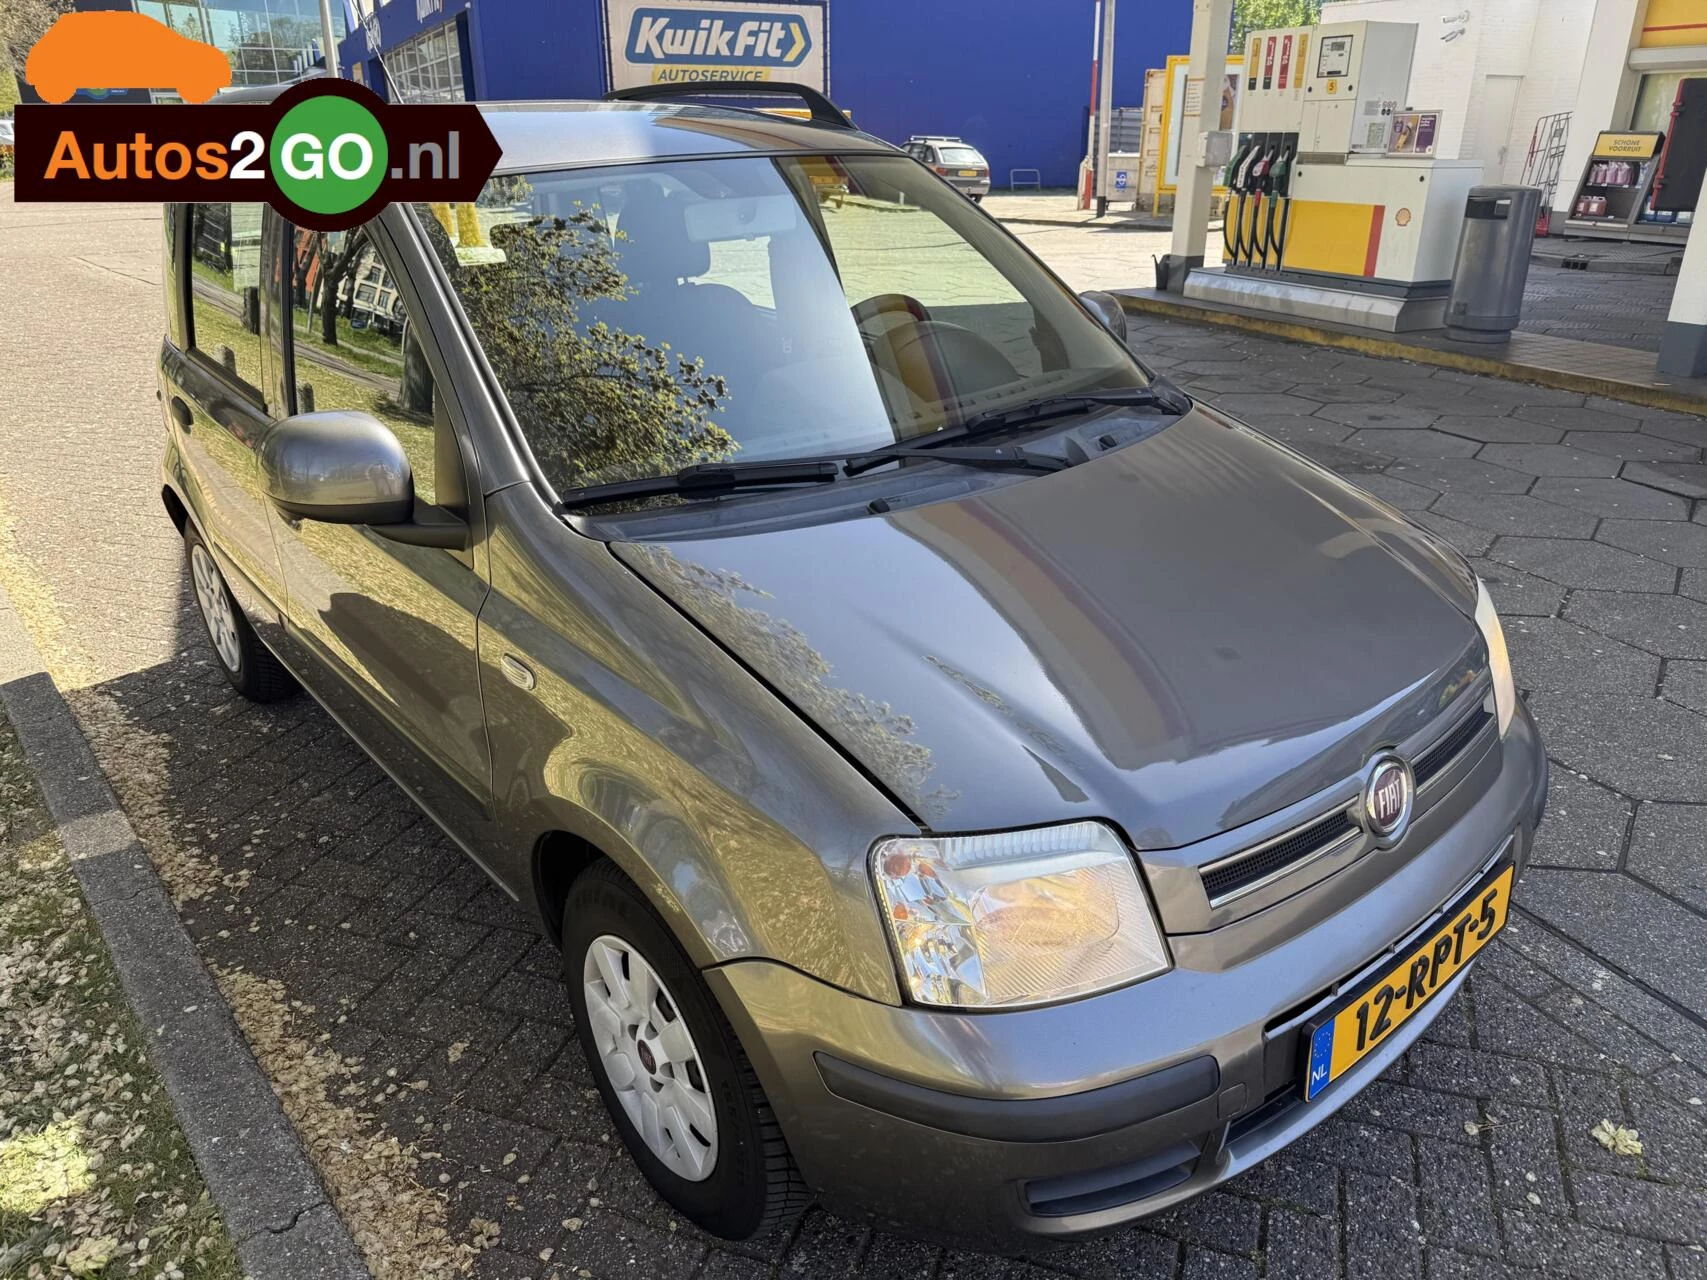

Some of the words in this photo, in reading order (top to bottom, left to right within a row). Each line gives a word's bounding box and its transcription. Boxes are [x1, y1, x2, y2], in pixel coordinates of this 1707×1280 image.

[657, 68, 764, 82] AUTOSERVICE
[1378, 778, 1400, 819] FIAT
[1356, 888, 1498, 1051] 12-RPT-5
[1311, 1062, 1327, 1086] NL
